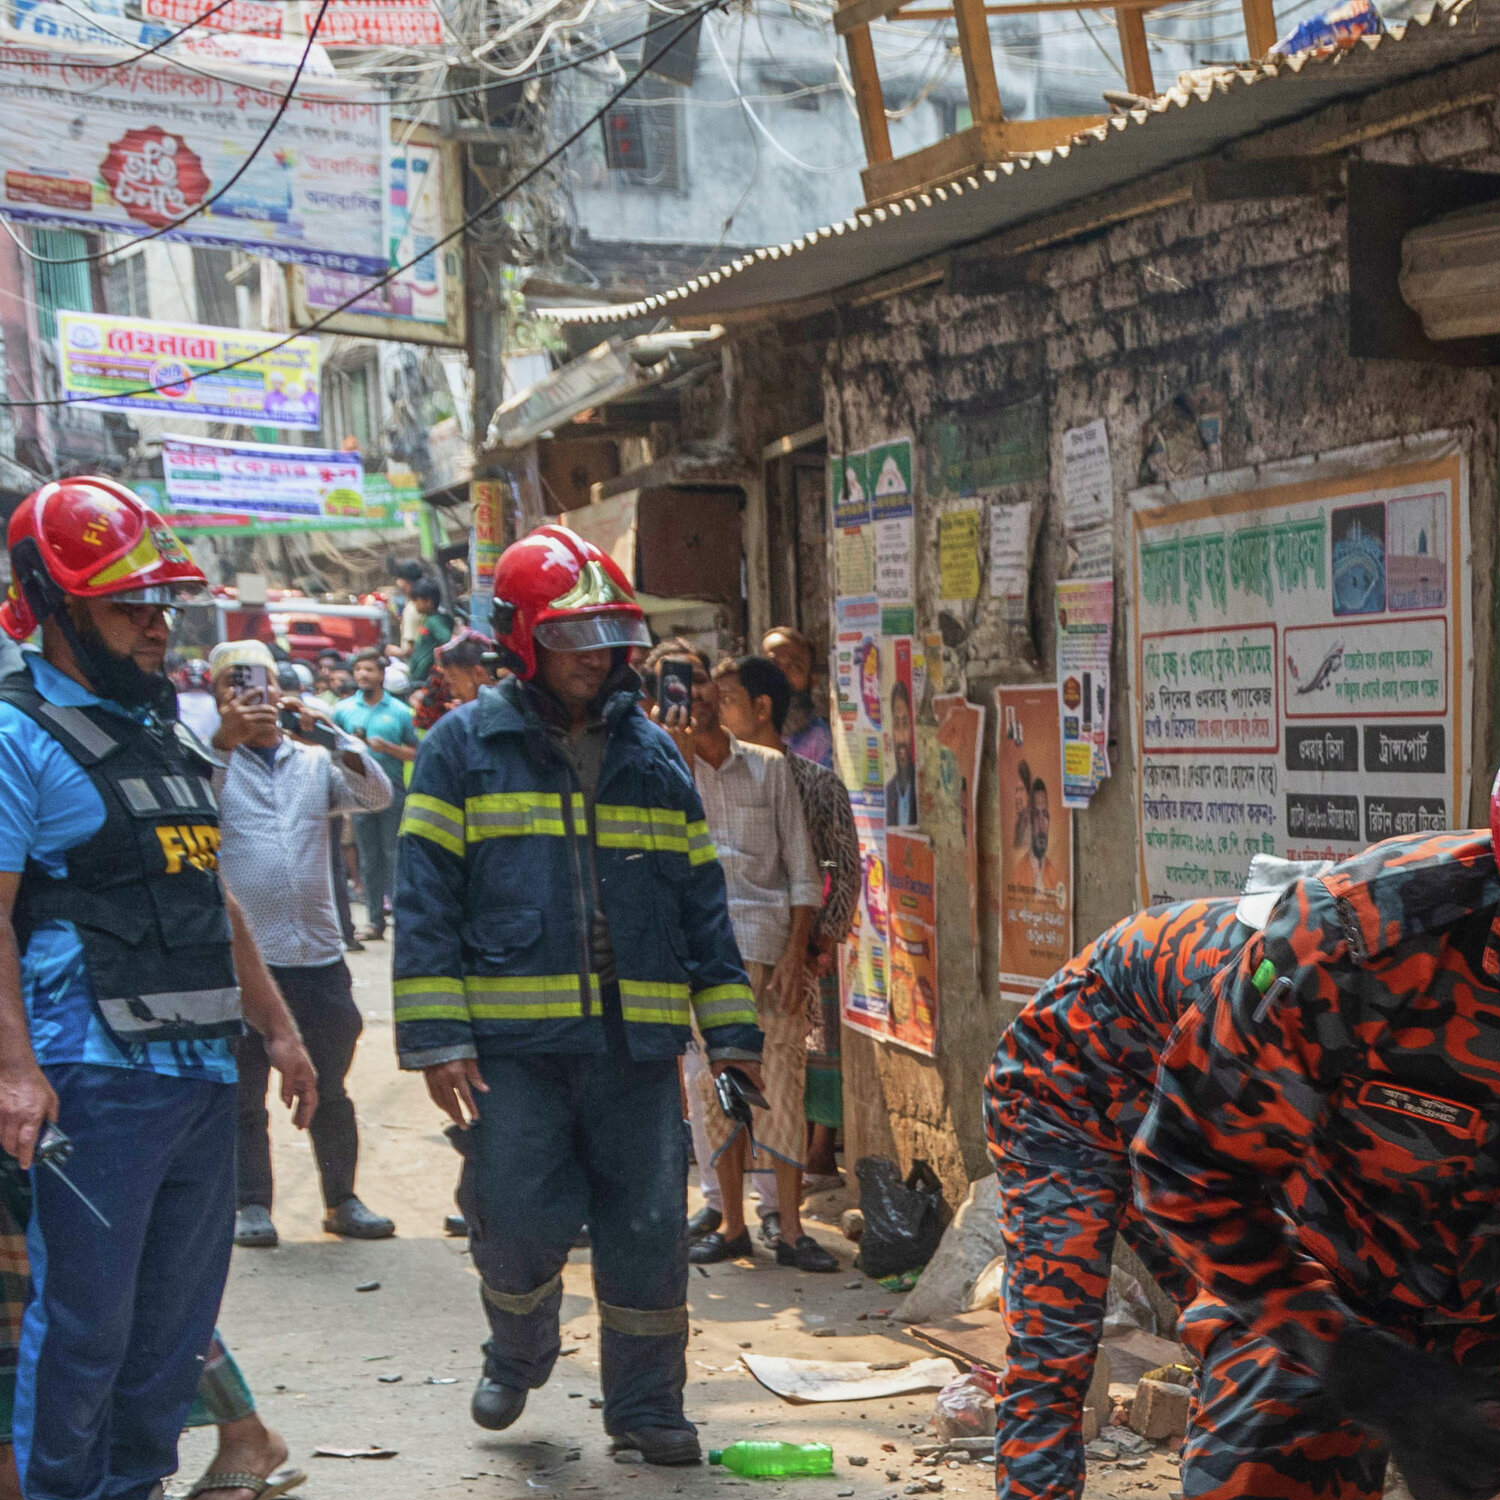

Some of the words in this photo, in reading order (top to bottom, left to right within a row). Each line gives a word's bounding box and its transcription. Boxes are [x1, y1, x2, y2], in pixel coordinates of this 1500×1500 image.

[1159, 685, 1191, 711] দিনের
[1231, 687, 1271, 709] প্যাকেজ
[155, 825, 222, 875] FIR
